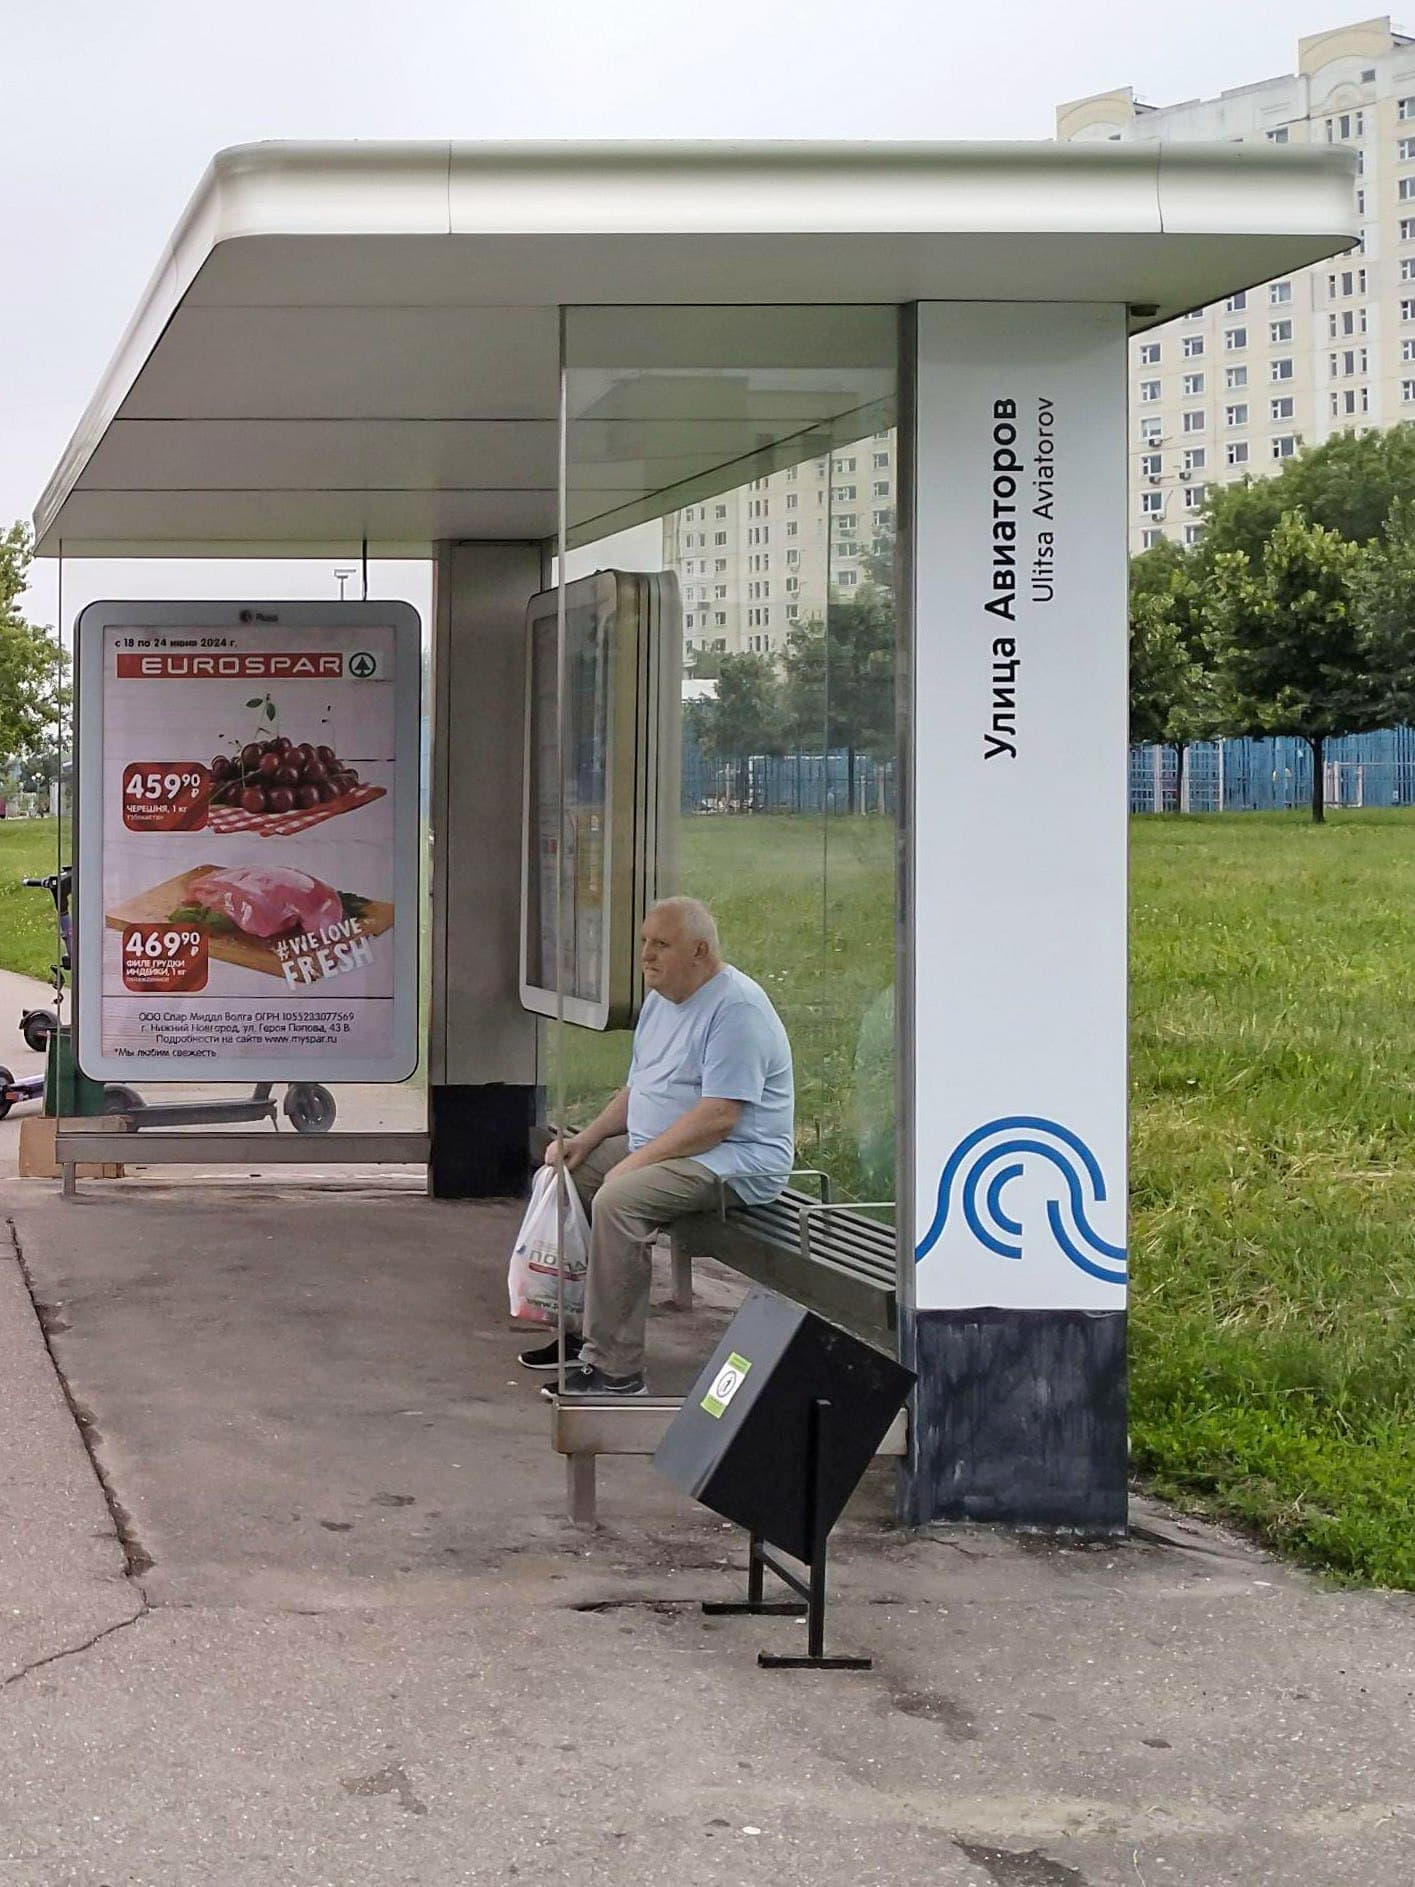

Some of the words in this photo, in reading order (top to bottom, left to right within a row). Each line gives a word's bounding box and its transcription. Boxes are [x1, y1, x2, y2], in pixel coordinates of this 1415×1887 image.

[1032, 396, 1055, 520] Aviatorov
[984, 397, 1024, 621] Авиаторов
[1032, 530, 1054, 603] Ulitsa
[124, 638, 135, 648] 18
[137, 639, 151, 648] по
[153, 638, 167, 648] 24
[200, 638, 227, 648] 2024
[140, 656, 341, 675] EUROSPAR
[984, 636, 1020, 760] Улица
[275, 931, 320, 962] #WE
[319, 917, 363, 945] LOVE
[126, 959, 152, 969] ФИЛЕ
[153, 959, 185, 969] ГРУДКИ
[281, 935, 375, 991] FRESH
[138, 1011, 161, 1022] ООО
[163, 1011, 187, 1024] Спар
[189, 1011, 223, 1023] Миддл
[224, 1011, 253, 1022] Волга
[254, 1011, 280, 1021] ОГРН
[150, 1023, 189, 1033] Нижний
[329, 1023, 341, 1033] 43
[156, 1035, 221, 1045] Подробности
[222, 1036, 233, 1044] на
[235, 1034, 263, 1044] сайте
[137, 1048, 170, 1058] любим
[172, 1048, 217, 1058] свежесть
